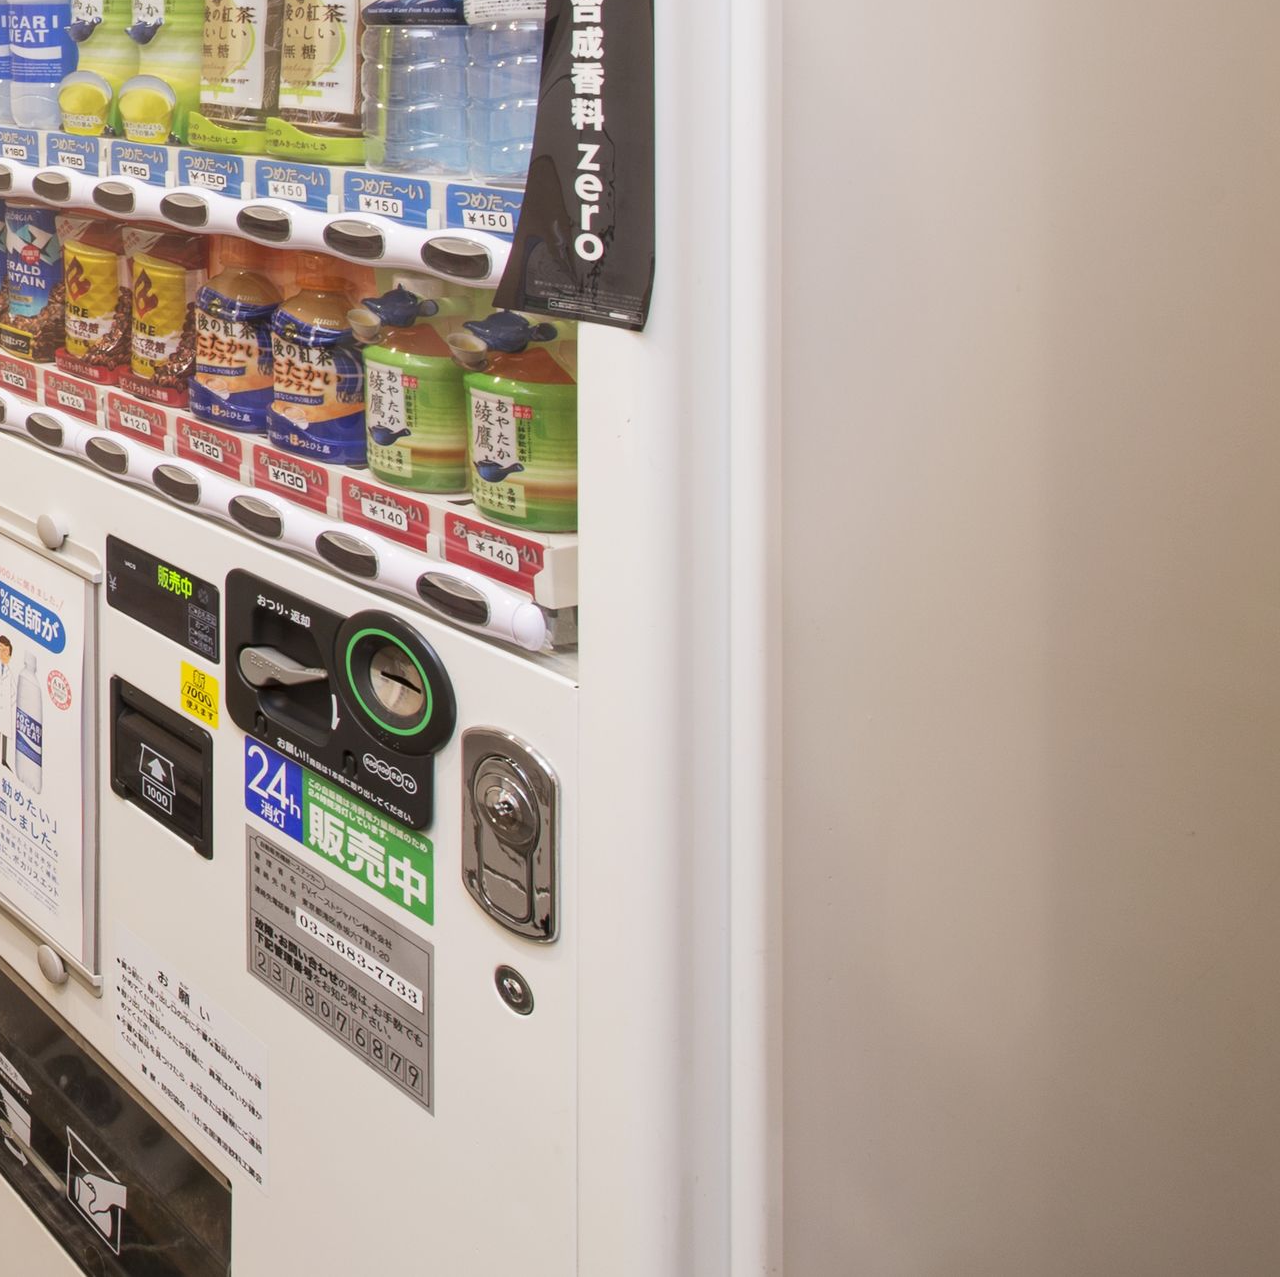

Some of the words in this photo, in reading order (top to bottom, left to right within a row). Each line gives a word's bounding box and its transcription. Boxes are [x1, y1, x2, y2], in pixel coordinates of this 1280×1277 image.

[283, 43, 316, 60] 無糖
[191, 171, 225, 185] ¥150
[272, 183, 302, 197] ¥150
[364, 198, 399, 214] ¥150
[454, 190, 521, 213] つめた〜
[468, 210, 508, 228] ¥150
[368, 371, 386, 419] 綾鷹
[386, 370, 400, 426] あやたか
[475, 401, 494, 453] 綾鷹
[495, 400, 511, 461] あやたか
[191, 438, 219, 459] ¥130
[272, 468, 304, 489] ¥130
[368, 504, 403, 526] ¥140
[475, 541, 514, 566] ¥140
[157, 564, 192, 600] 販売中
[256, 594, 311, 628] おつり・返却
[193, 669, 206, 688] 新
[185, 683, 212, 708] 1000
[146, 783, 168, 807] 1000
[404, 779, 414, 789] 10
[260, 799, 286, 829] 消灯
[308, 802, 427, 907] 販売中
[299, 913, 418, 1006] 03-5683-7733
[157, 970, 211, 1022] お願い
